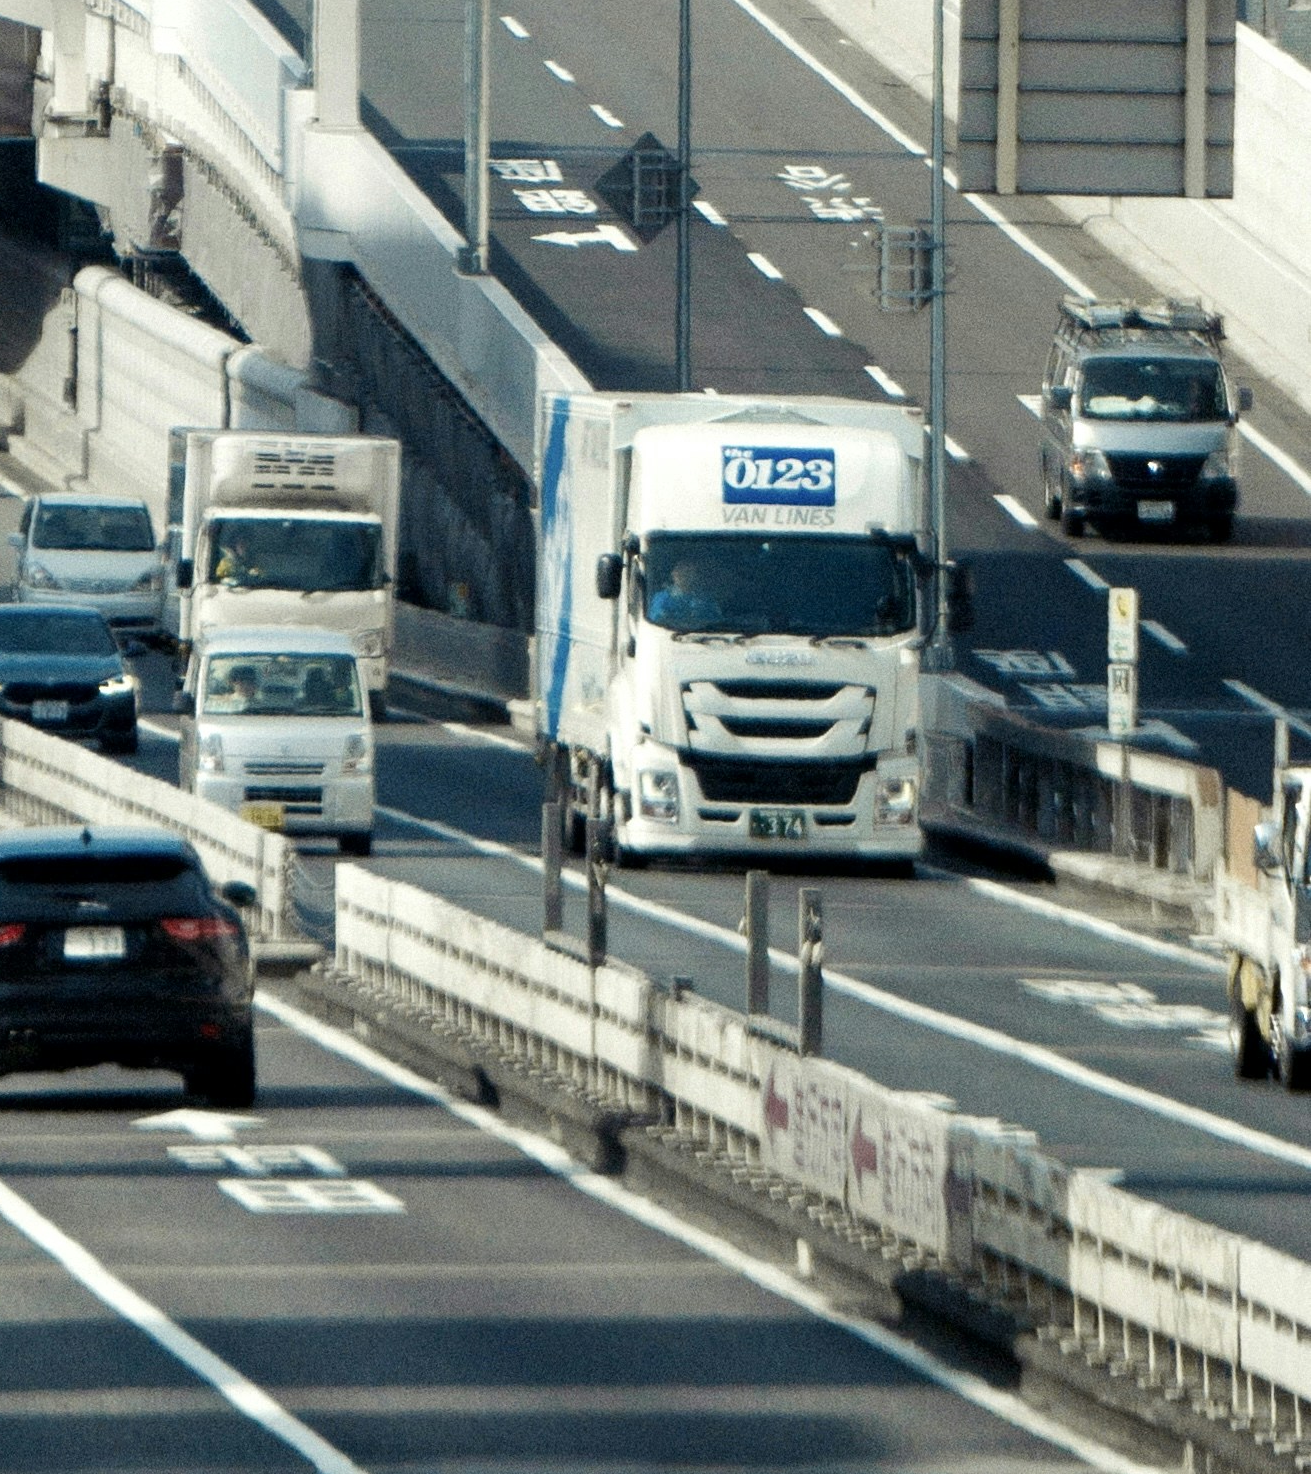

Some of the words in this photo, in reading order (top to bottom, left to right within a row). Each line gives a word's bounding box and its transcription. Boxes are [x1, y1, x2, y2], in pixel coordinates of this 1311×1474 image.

[725, 458, 833, 490] 0123
[723, 508, 766, 524] VAN
[775, 509, 835, 526] LINES
